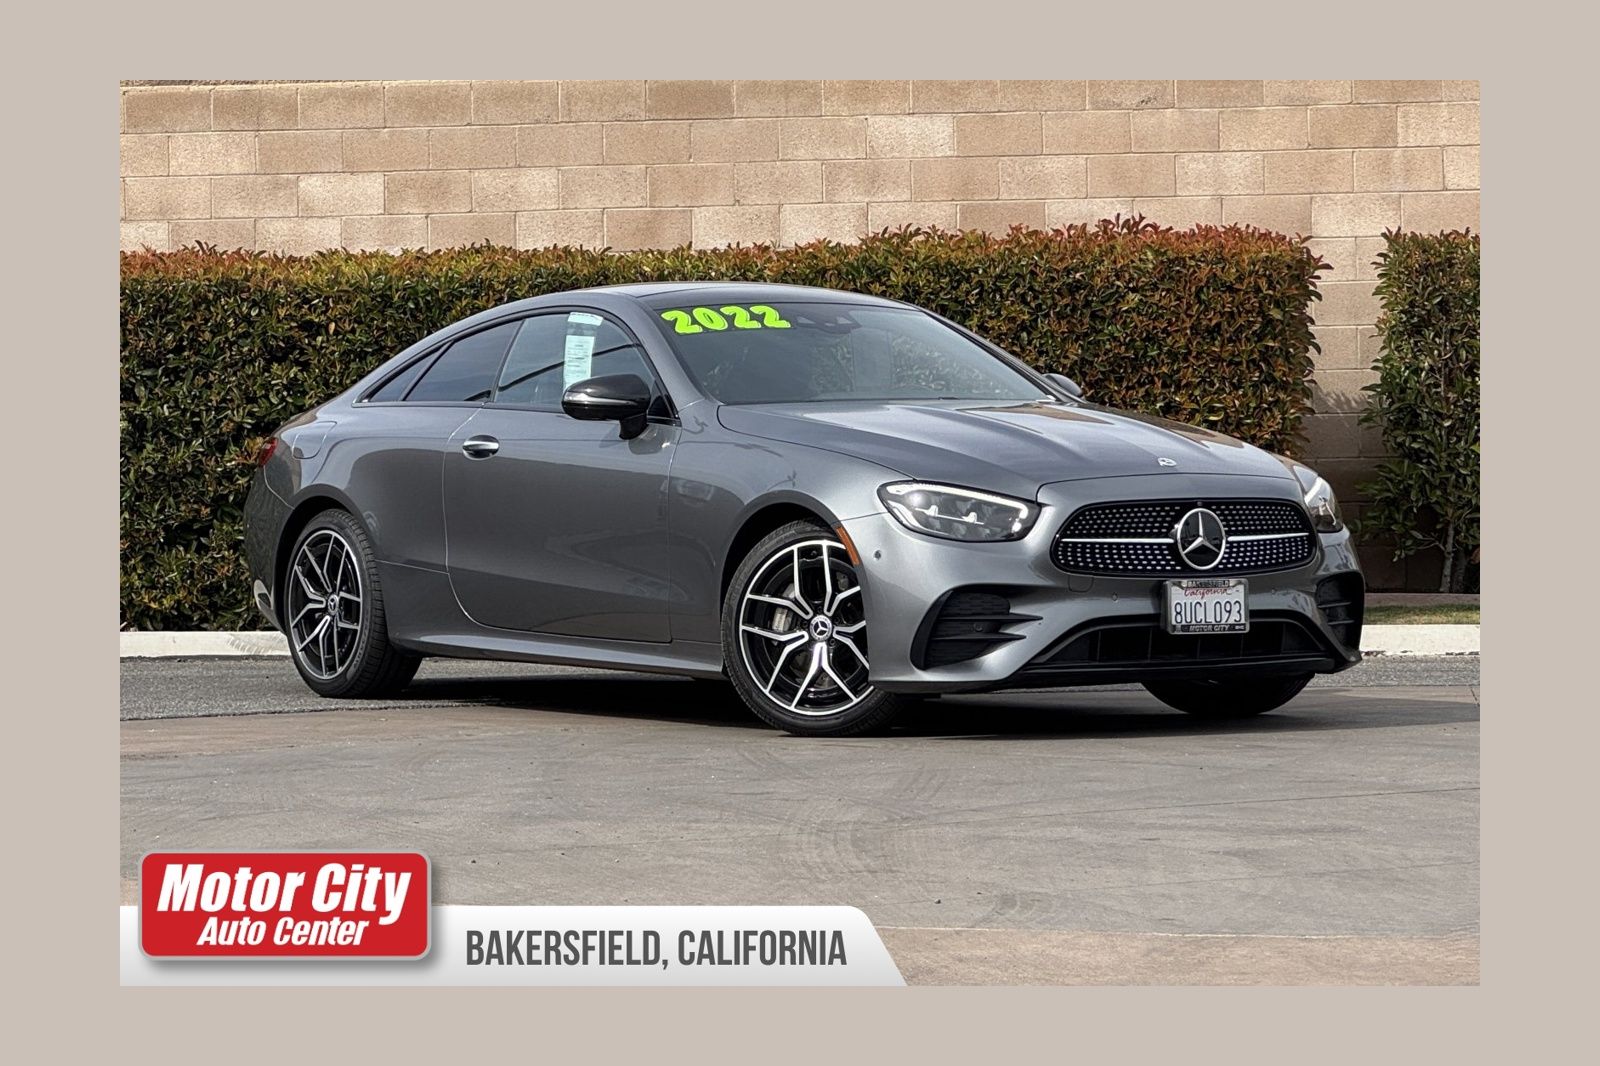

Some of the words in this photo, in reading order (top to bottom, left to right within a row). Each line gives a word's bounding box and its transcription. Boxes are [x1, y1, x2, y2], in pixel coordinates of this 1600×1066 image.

[661, 305, 791, 334] 2022
[1184, 588, 1232, 600] California
[1174, 600, 1242, 624] 8UCL093
